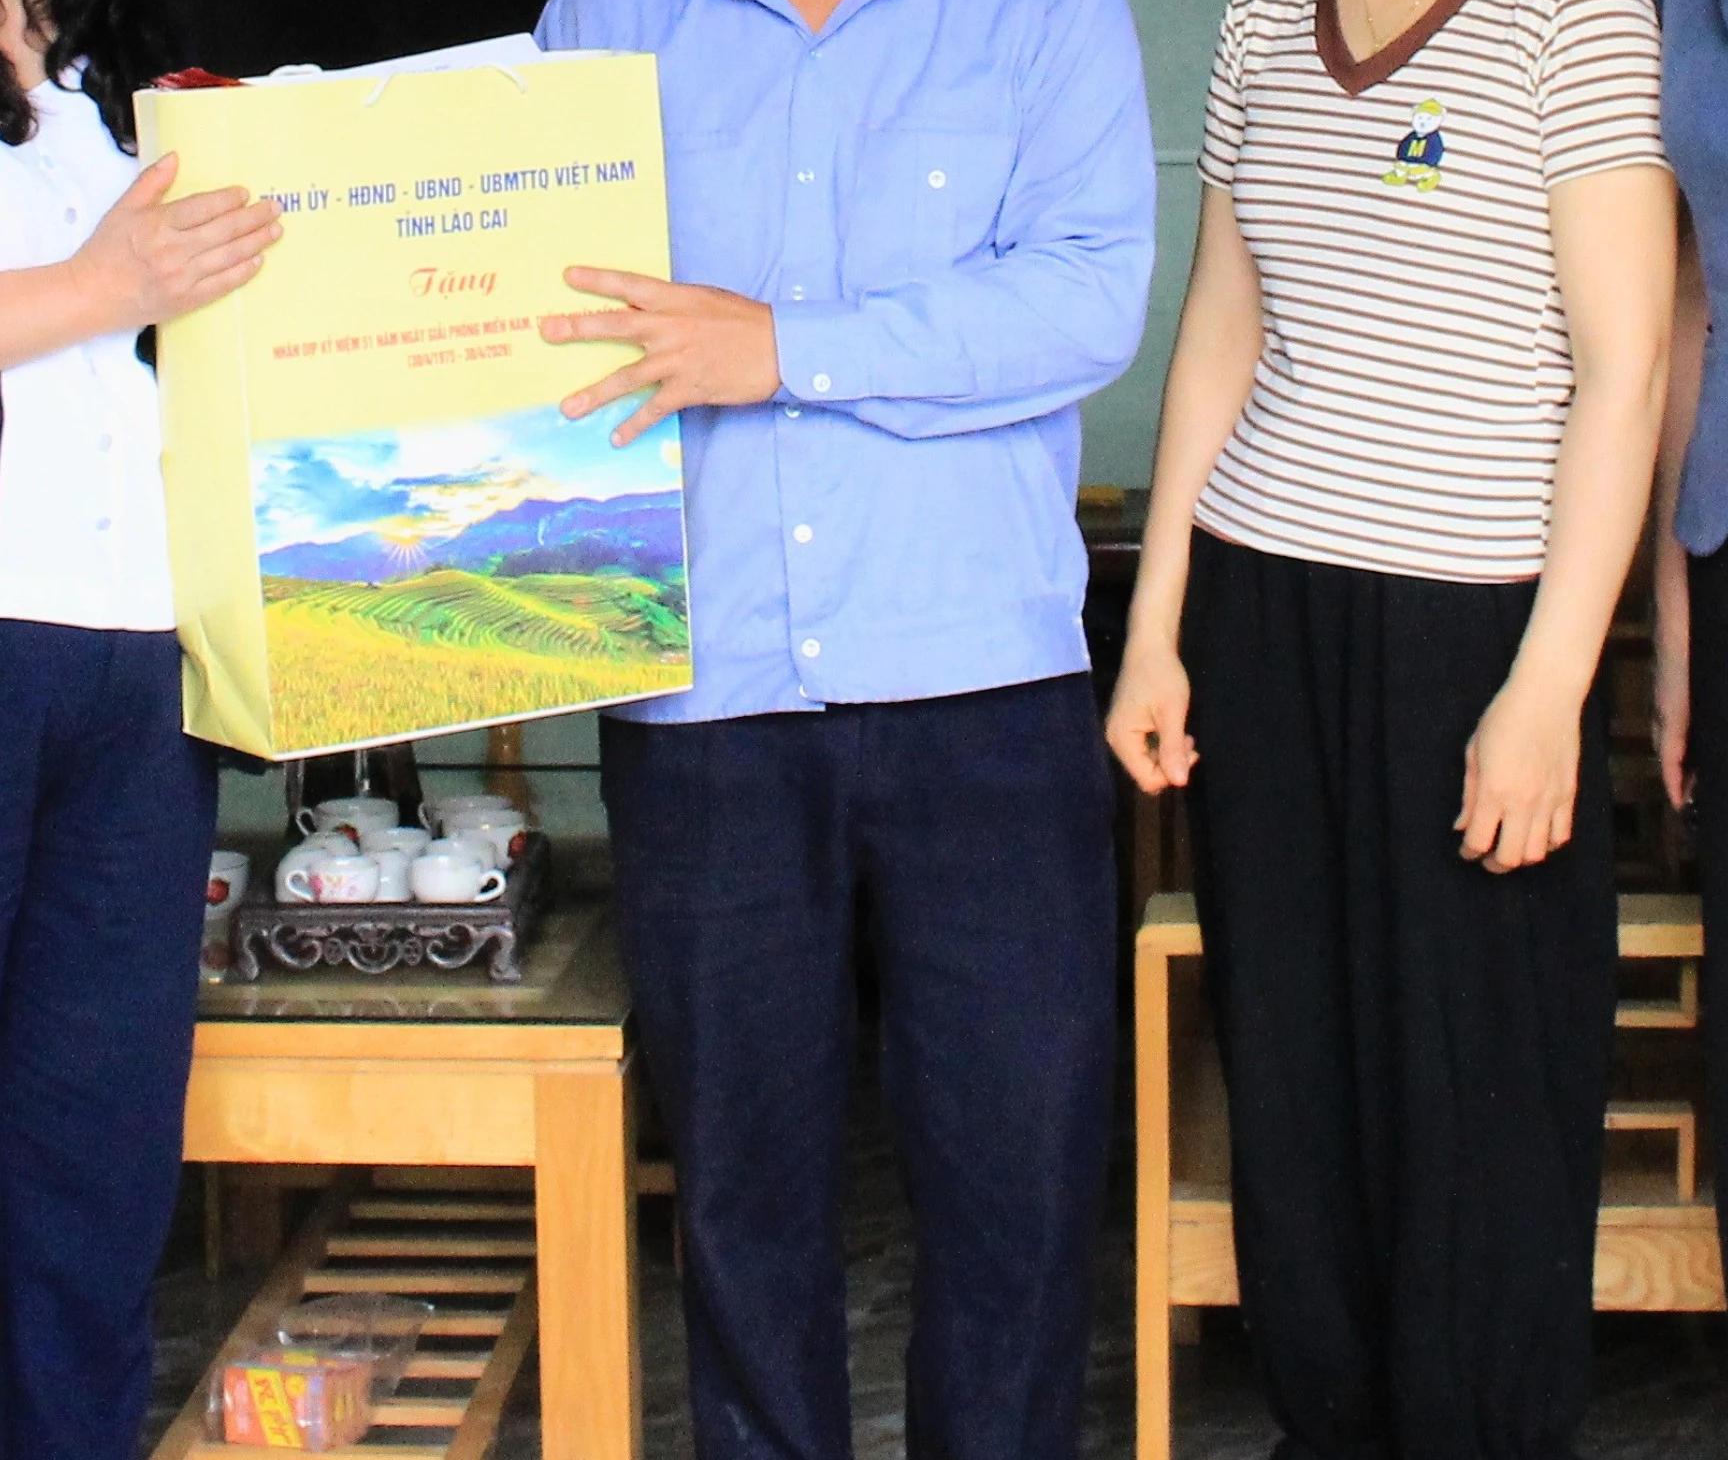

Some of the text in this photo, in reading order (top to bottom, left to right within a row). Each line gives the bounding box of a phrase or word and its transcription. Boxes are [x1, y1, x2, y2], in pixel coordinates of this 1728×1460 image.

[1406, 139, 1428, 158] M
[307, 183, 330, 211] ỦY
[348, 183, 396, 207] HĐND
[415, 177, 462, 200] UBND
[480, 168, 549, 194] UBMTTQ
[554, 161, 590, 190] VIỆT
[596, 160, 635, 182] NAM
[396, 210, 435, 237] TỈNH
[480, 208, 508, 230] CAI
[409, 267, 498, 300] Tặng
